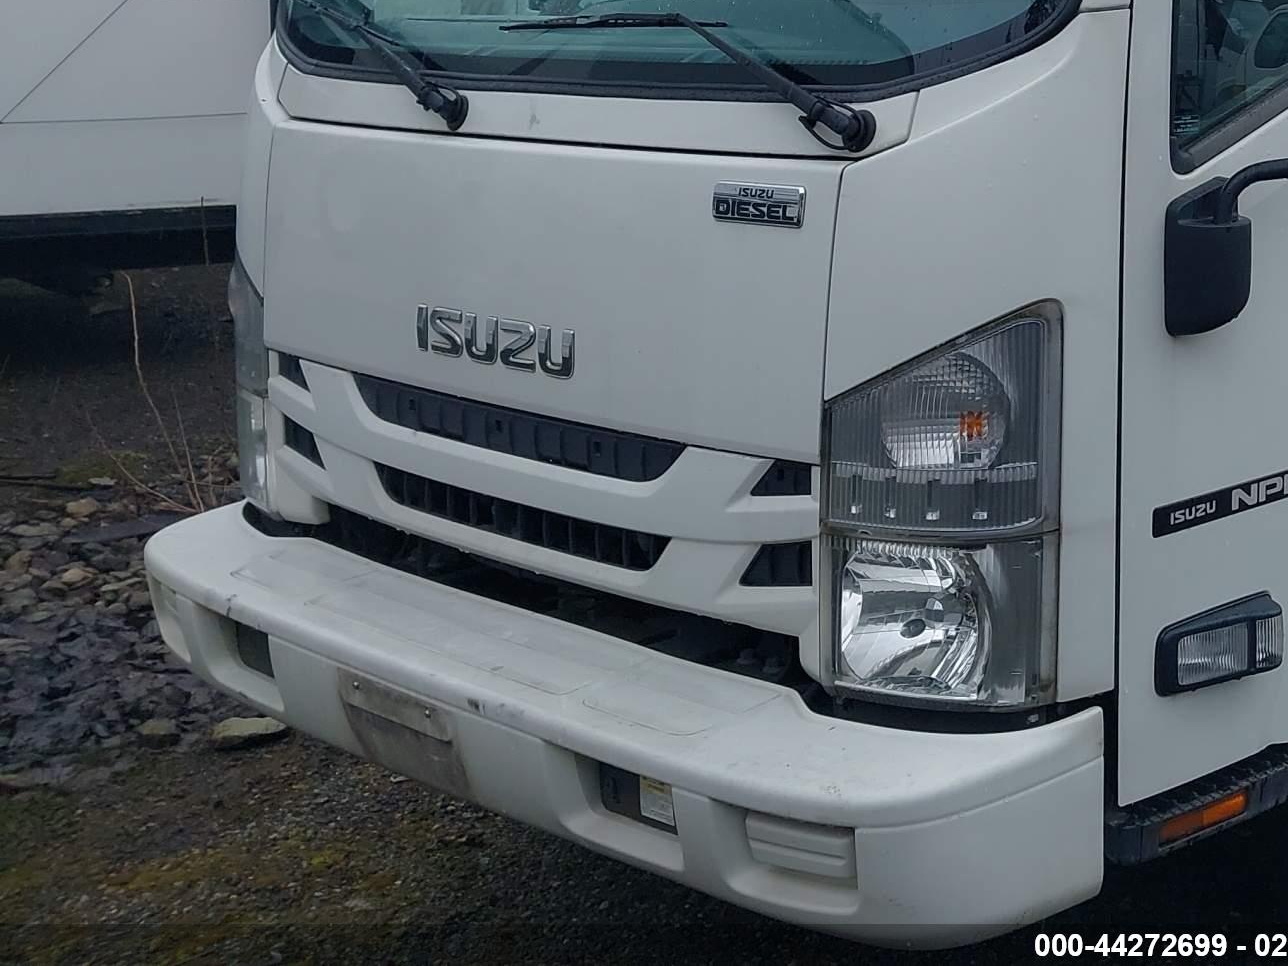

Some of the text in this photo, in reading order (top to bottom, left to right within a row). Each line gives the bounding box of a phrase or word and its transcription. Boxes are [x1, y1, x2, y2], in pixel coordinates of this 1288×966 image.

[738, 187, 775, 199] ISUZU
[715, 199, 798, 222] DIESEL
[416, 303, 576, 380] ISUZU
[1169, 500, 1217, 526] ISUZU
